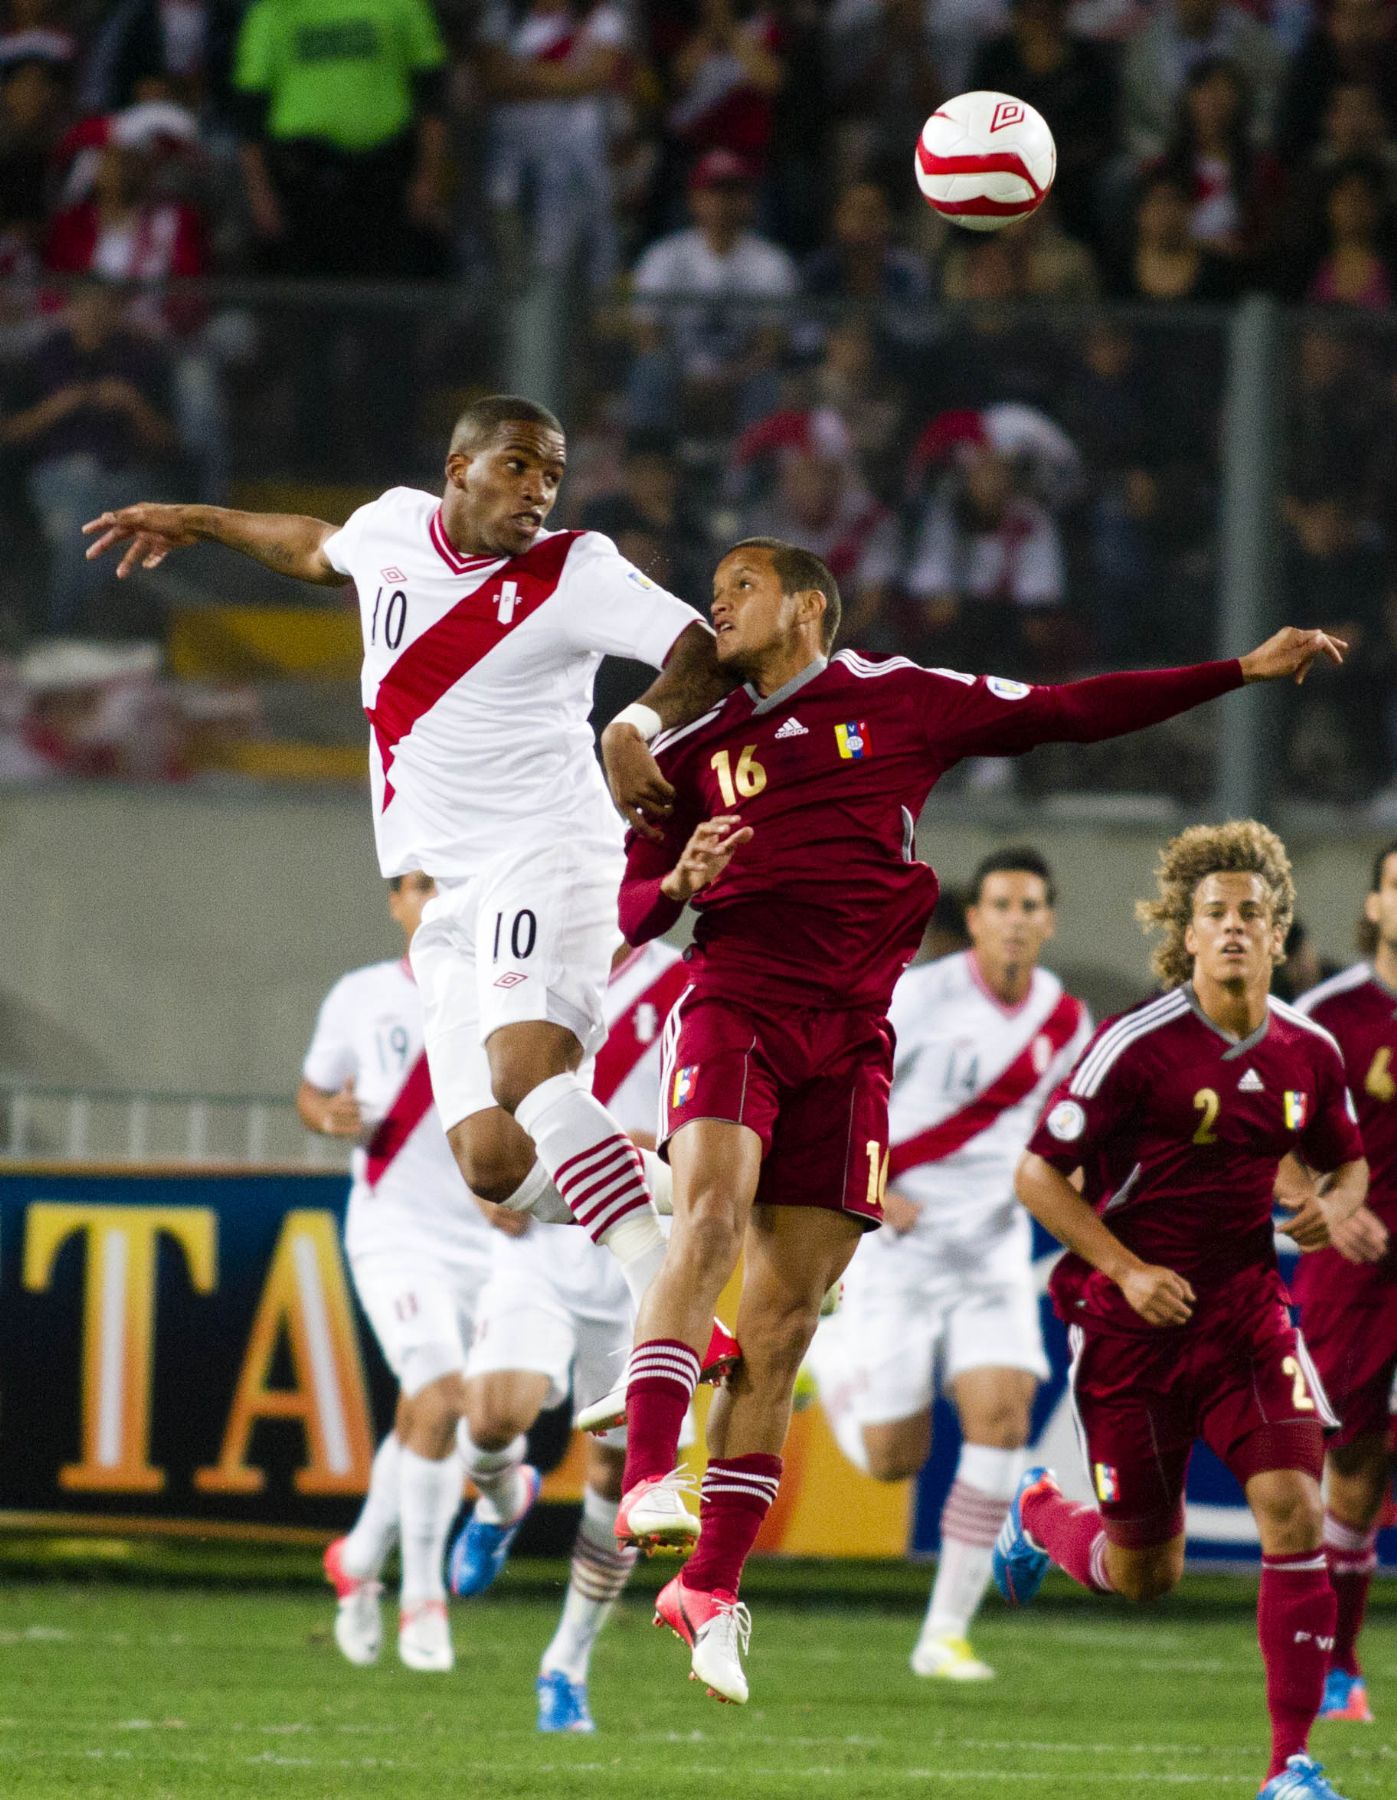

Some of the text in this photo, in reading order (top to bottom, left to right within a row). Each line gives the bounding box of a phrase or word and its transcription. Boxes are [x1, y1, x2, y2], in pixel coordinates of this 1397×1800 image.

[371, 586, 408, 650] 10
[774, 727, 809, 739] adidas
[710, 744, 768, 808] 16
[493, 908, 537, 964] 10
[373, 1025, 410, 1074] 19
[1364, 1045, 1396, 1102] 6
[1193, 1088, 1220, 1144] 2
[1281, 1355, 1315, 1410] 2
